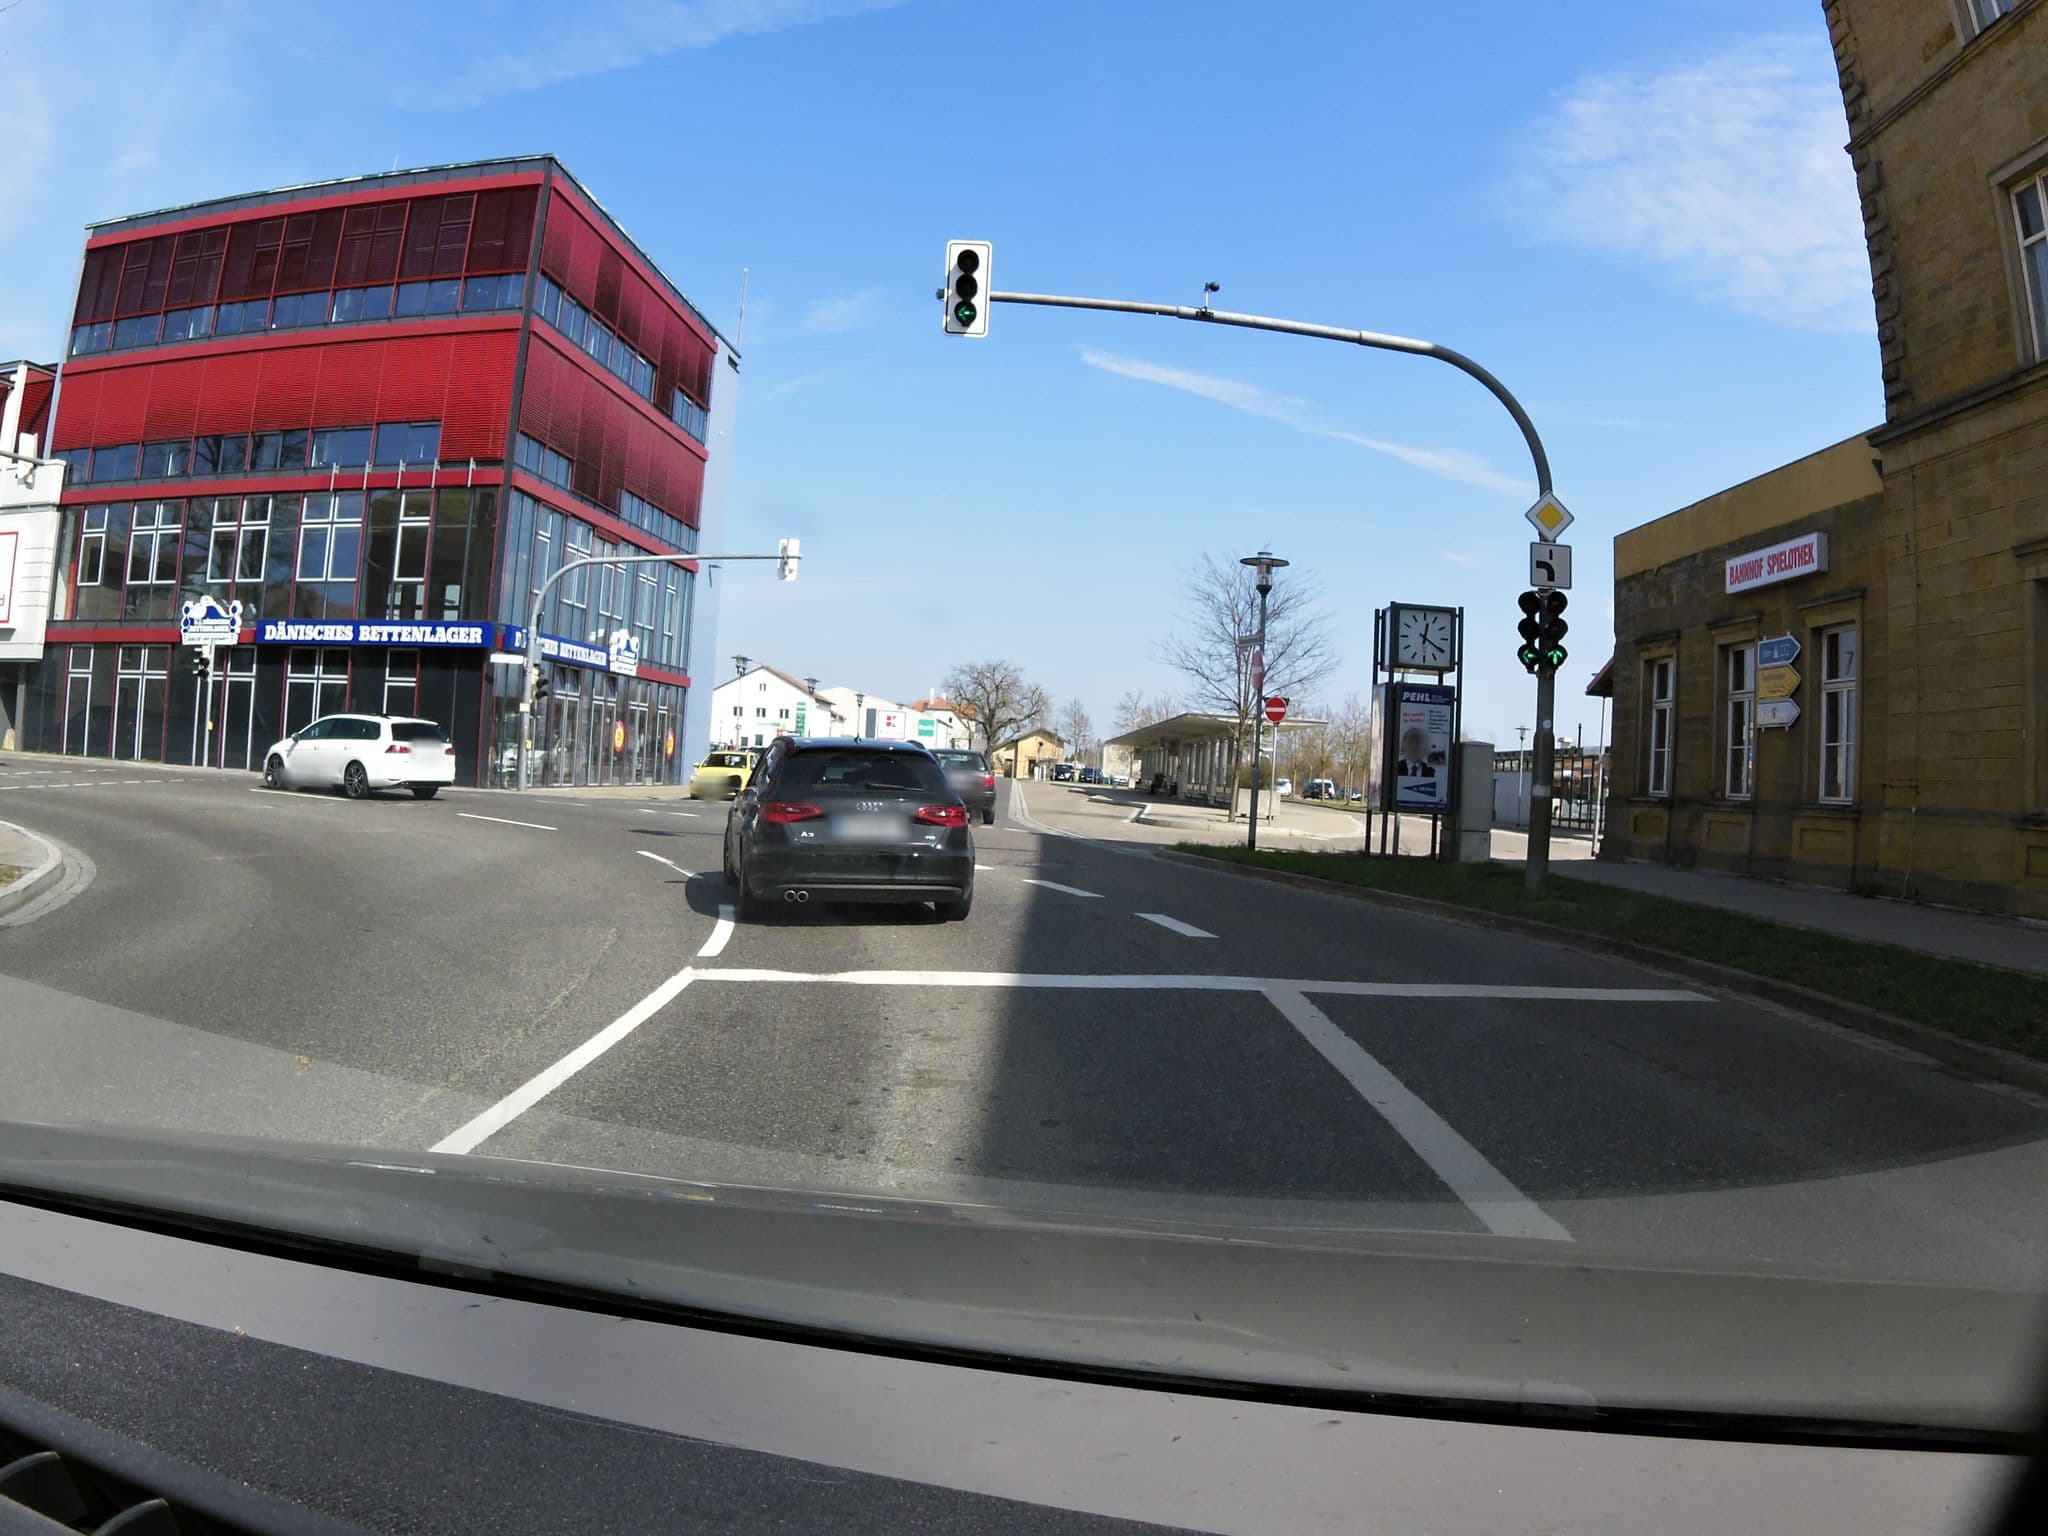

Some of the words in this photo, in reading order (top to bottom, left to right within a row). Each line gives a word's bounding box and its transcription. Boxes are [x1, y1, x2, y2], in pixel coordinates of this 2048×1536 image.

[1729, 556, 1764, 585] BAHNHOF
[1766, 542, 1815, 577] SPIELOTHEK
[263, 621, 354, 642] DÄNISCHES
[358, 627, 484, 645] BETTENLAGER
[514, 628, 559, 656] DÄCHES
[1402, 691, 1431, 703] PEHL
